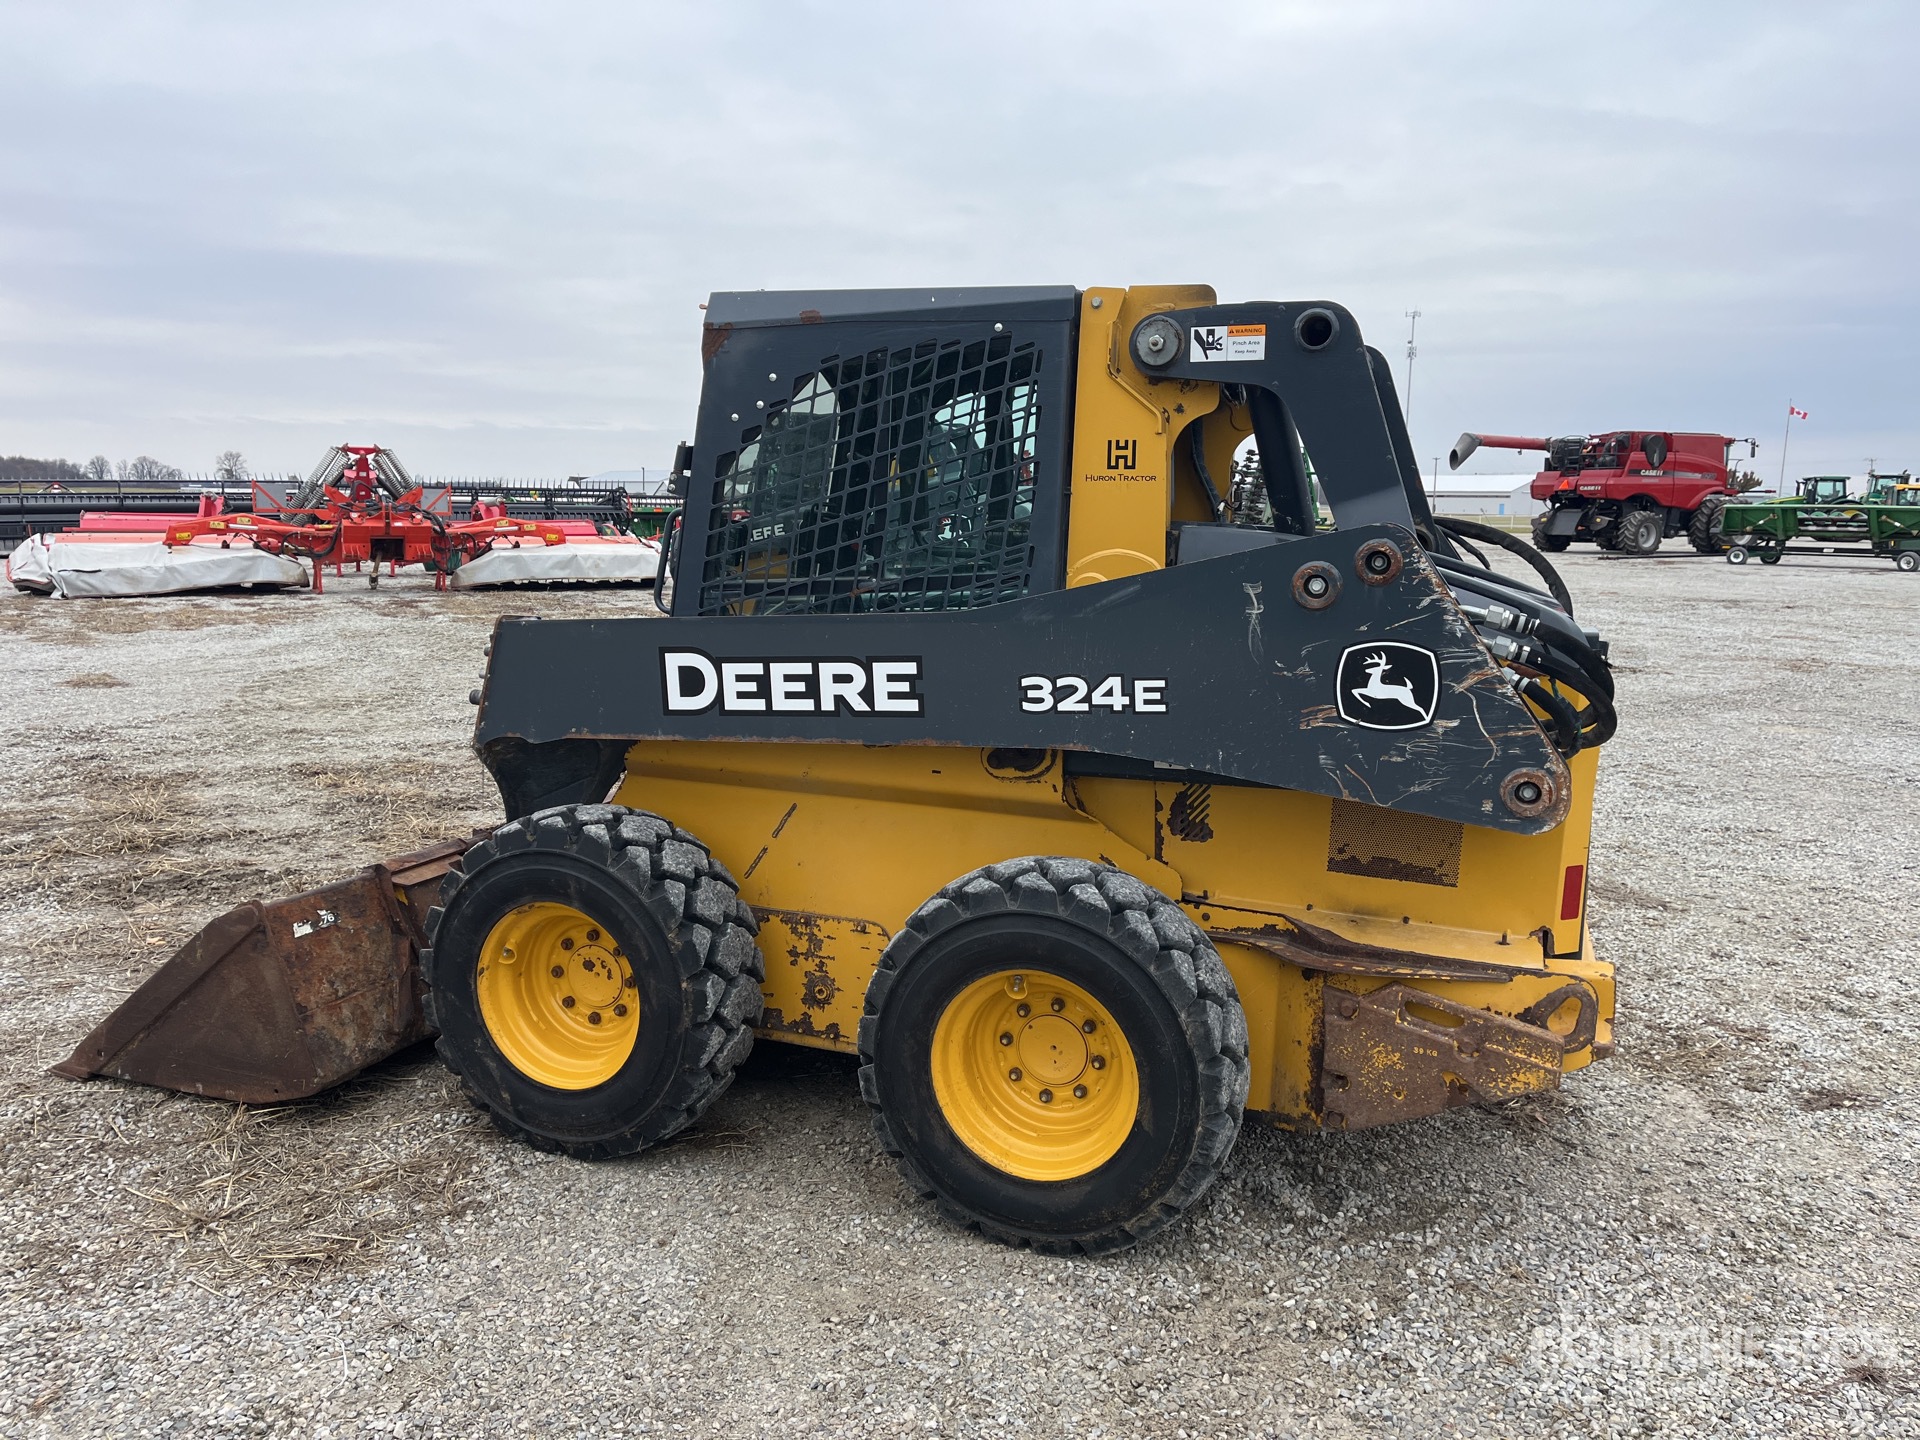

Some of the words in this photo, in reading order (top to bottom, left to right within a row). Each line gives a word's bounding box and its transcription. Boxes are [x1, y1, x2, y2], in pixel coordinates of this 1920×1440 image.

[1085, 474, 1116, 482] HURON
[1117, 473, 1157, 482] TRACTOR
[663, 652, 920, 712] DEERE
[1020, 676, 1167, 712] 324E
[1426, 1049, 1438, 1057] KG
